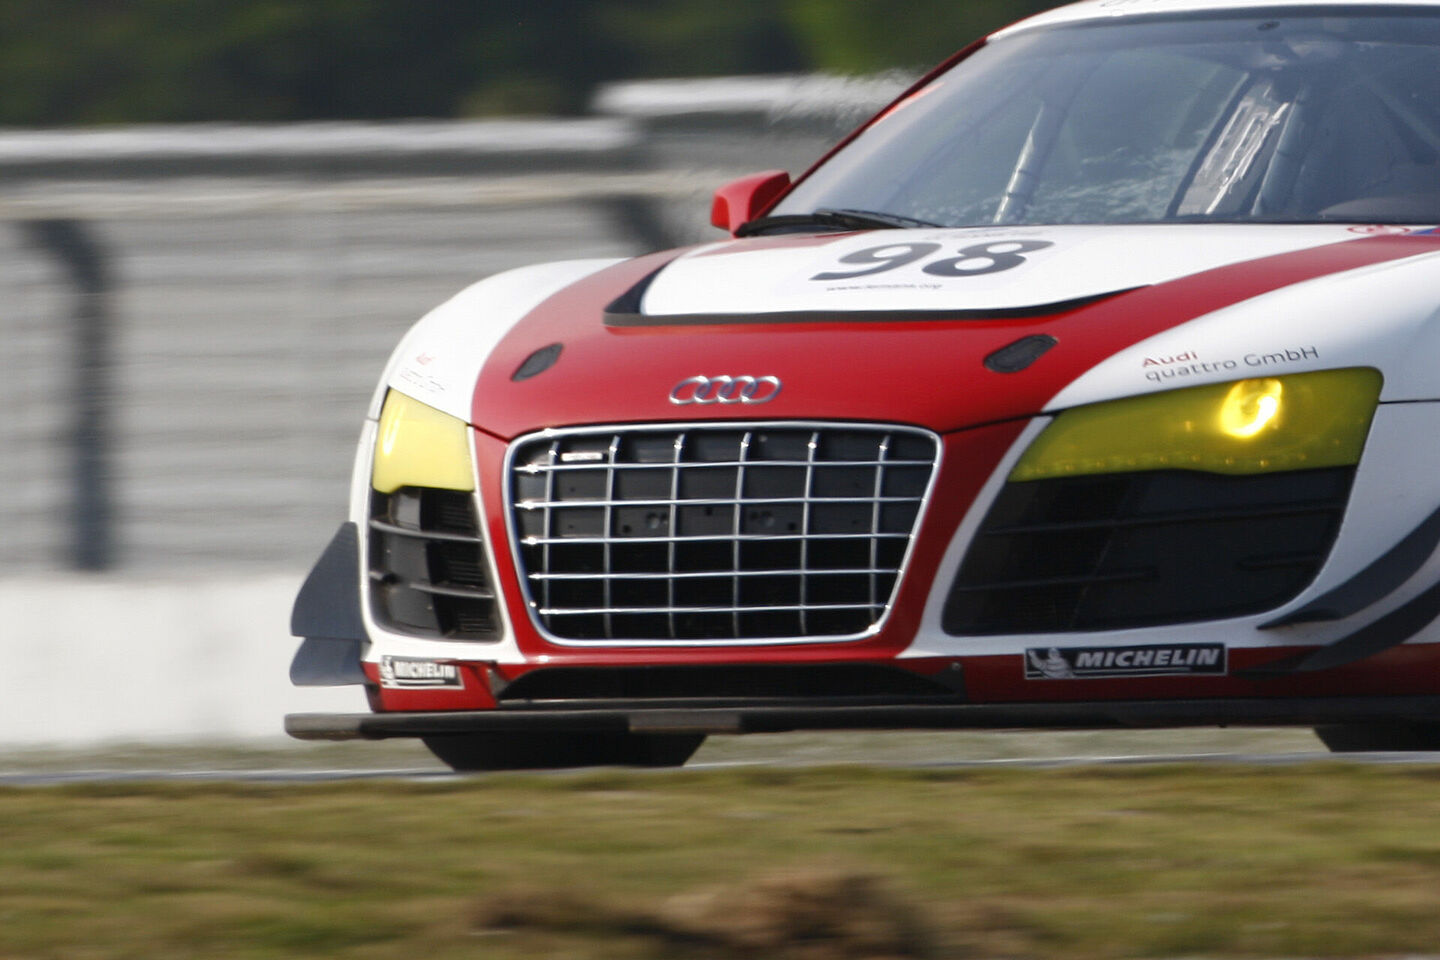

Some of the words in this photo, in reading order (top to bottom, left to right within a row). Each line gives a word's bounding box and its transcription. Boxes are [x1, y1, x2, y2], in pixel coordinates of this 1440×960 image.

[808, 239, 1056, 281] 98
[1142, 350, 1199, 368] Audi
[1145, 359, 1237, 383] quattro
[1243, 345, 1320, 367] GmbH
[1075, 648, 1221, 668] MICHELIN
